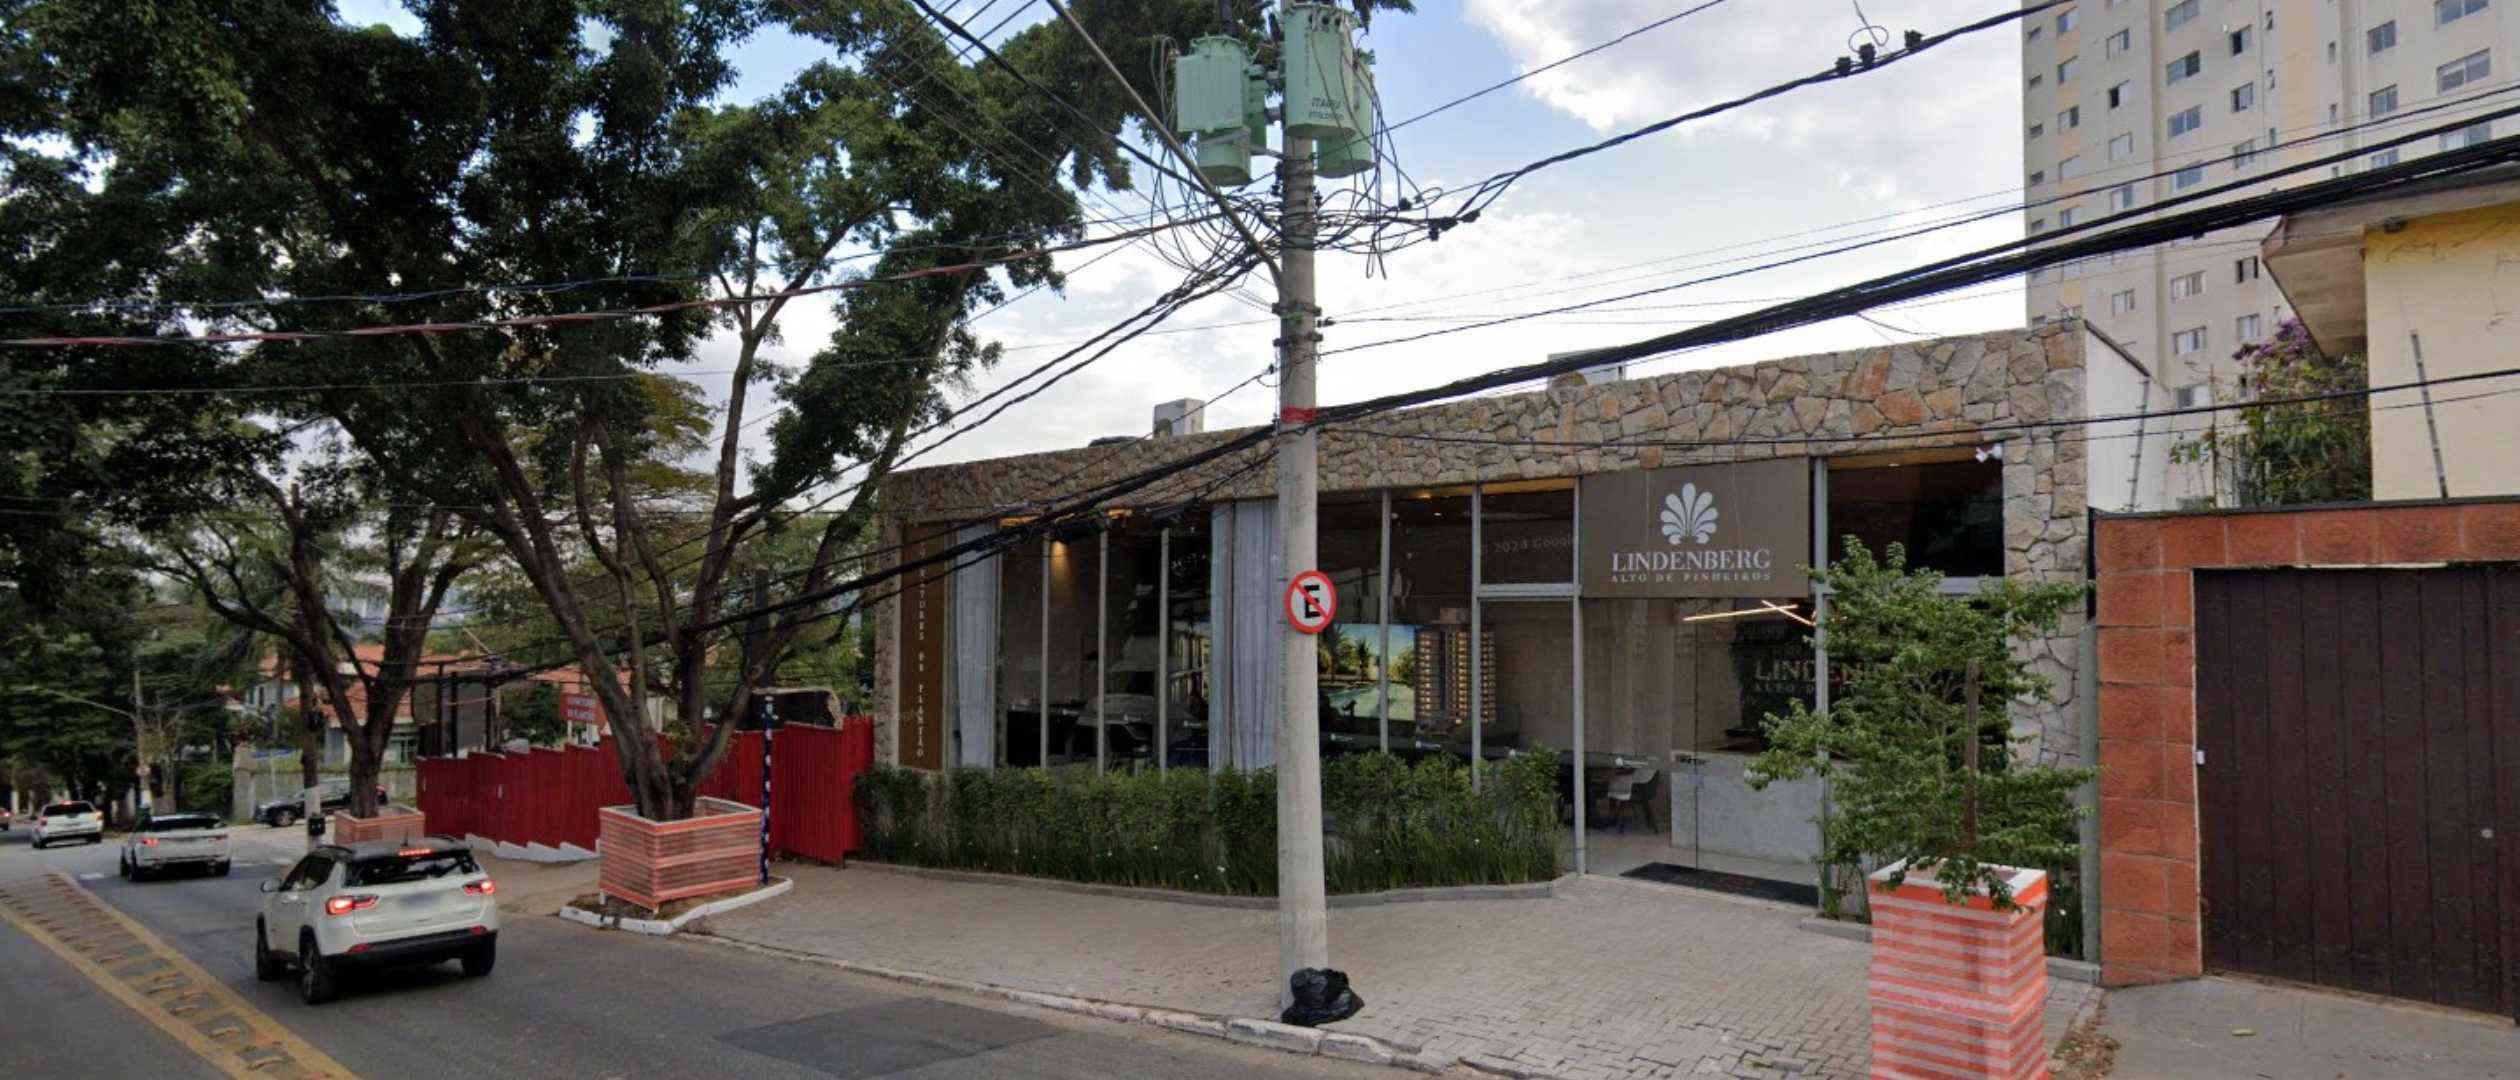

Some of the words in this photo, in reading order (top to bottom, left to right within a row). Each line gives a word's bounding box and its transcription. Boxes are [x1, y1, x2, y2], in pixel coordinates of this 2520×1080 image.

[1612, 548, 1771, 572] LINDENBERG
[1611, 574, 1648, 584] ALTO
[1655, 574, 1674, 583] DE
[1304, 584, 1321, 618] E
